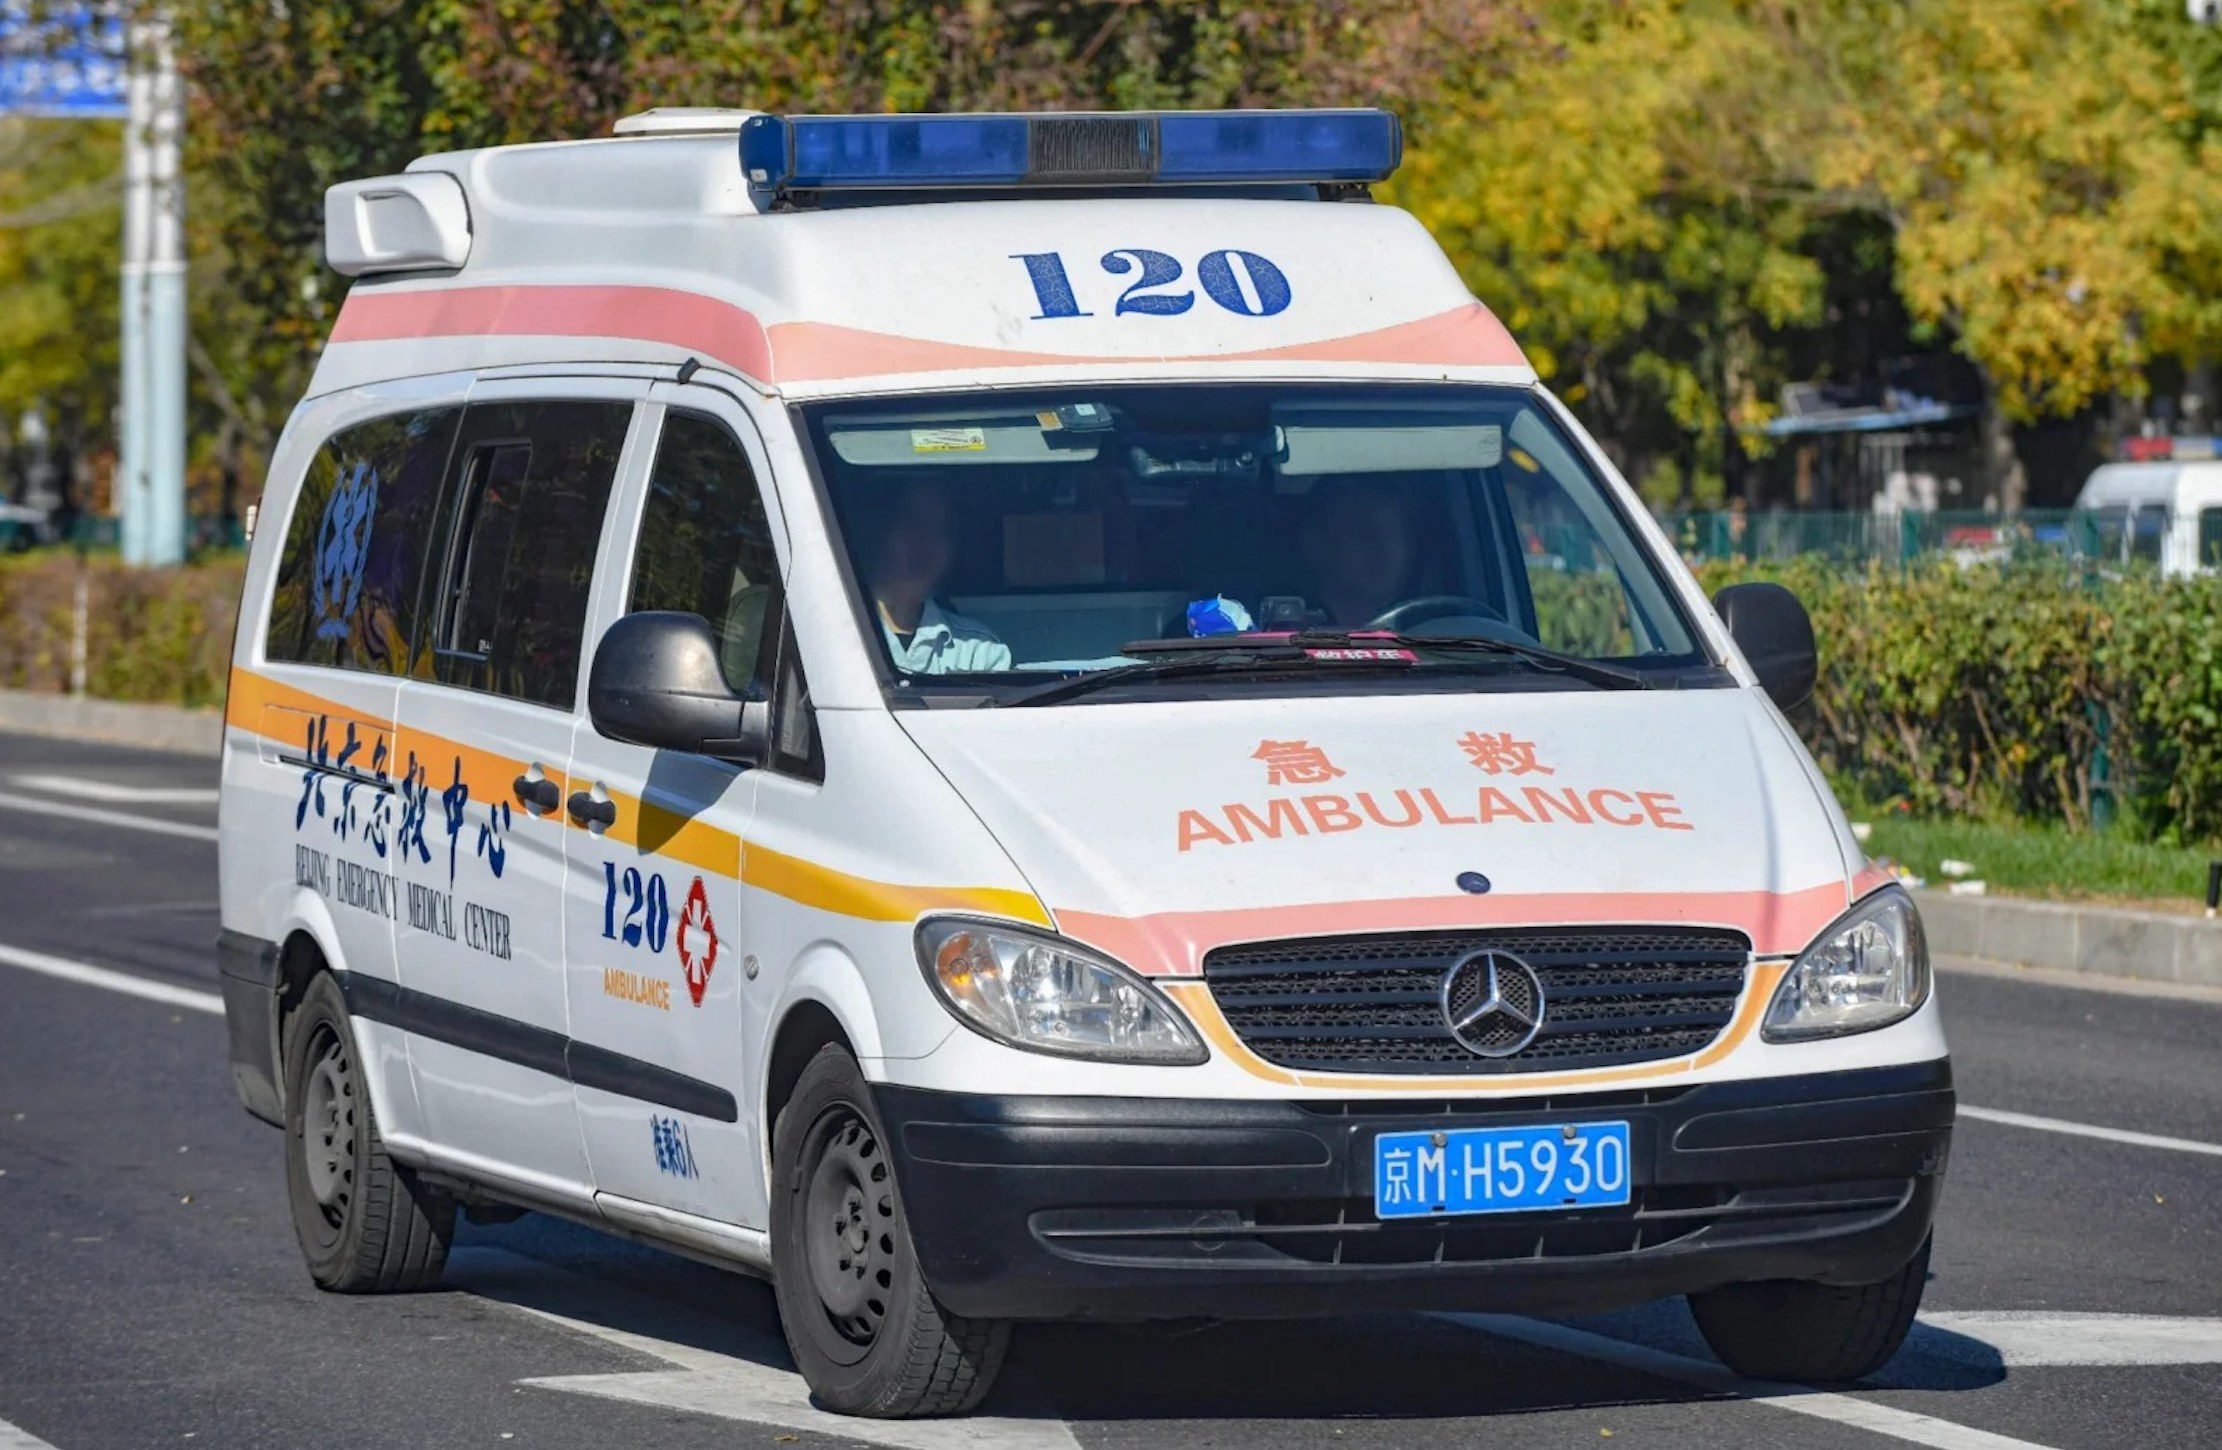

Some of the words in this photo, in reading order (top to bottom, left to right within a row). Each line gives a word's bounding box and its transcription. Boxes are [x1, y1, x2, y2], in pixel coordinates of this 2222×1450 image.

[1008, 249, 1292, 319] 120
[296, 714, 511, 890] 北京急救中心
[1177, 786, 1695, 851] AMBULANCE
[296, 844, 331, 898] BEIJING
[337, 859, 400, 921] EMERGENCY
[407, 881, 456, 941] MEDICAL
[465, 902, 512, 961] CENTER
[602, 861, 669, 953] 120
[604, 967, 671, 1011] AMBULANCE
